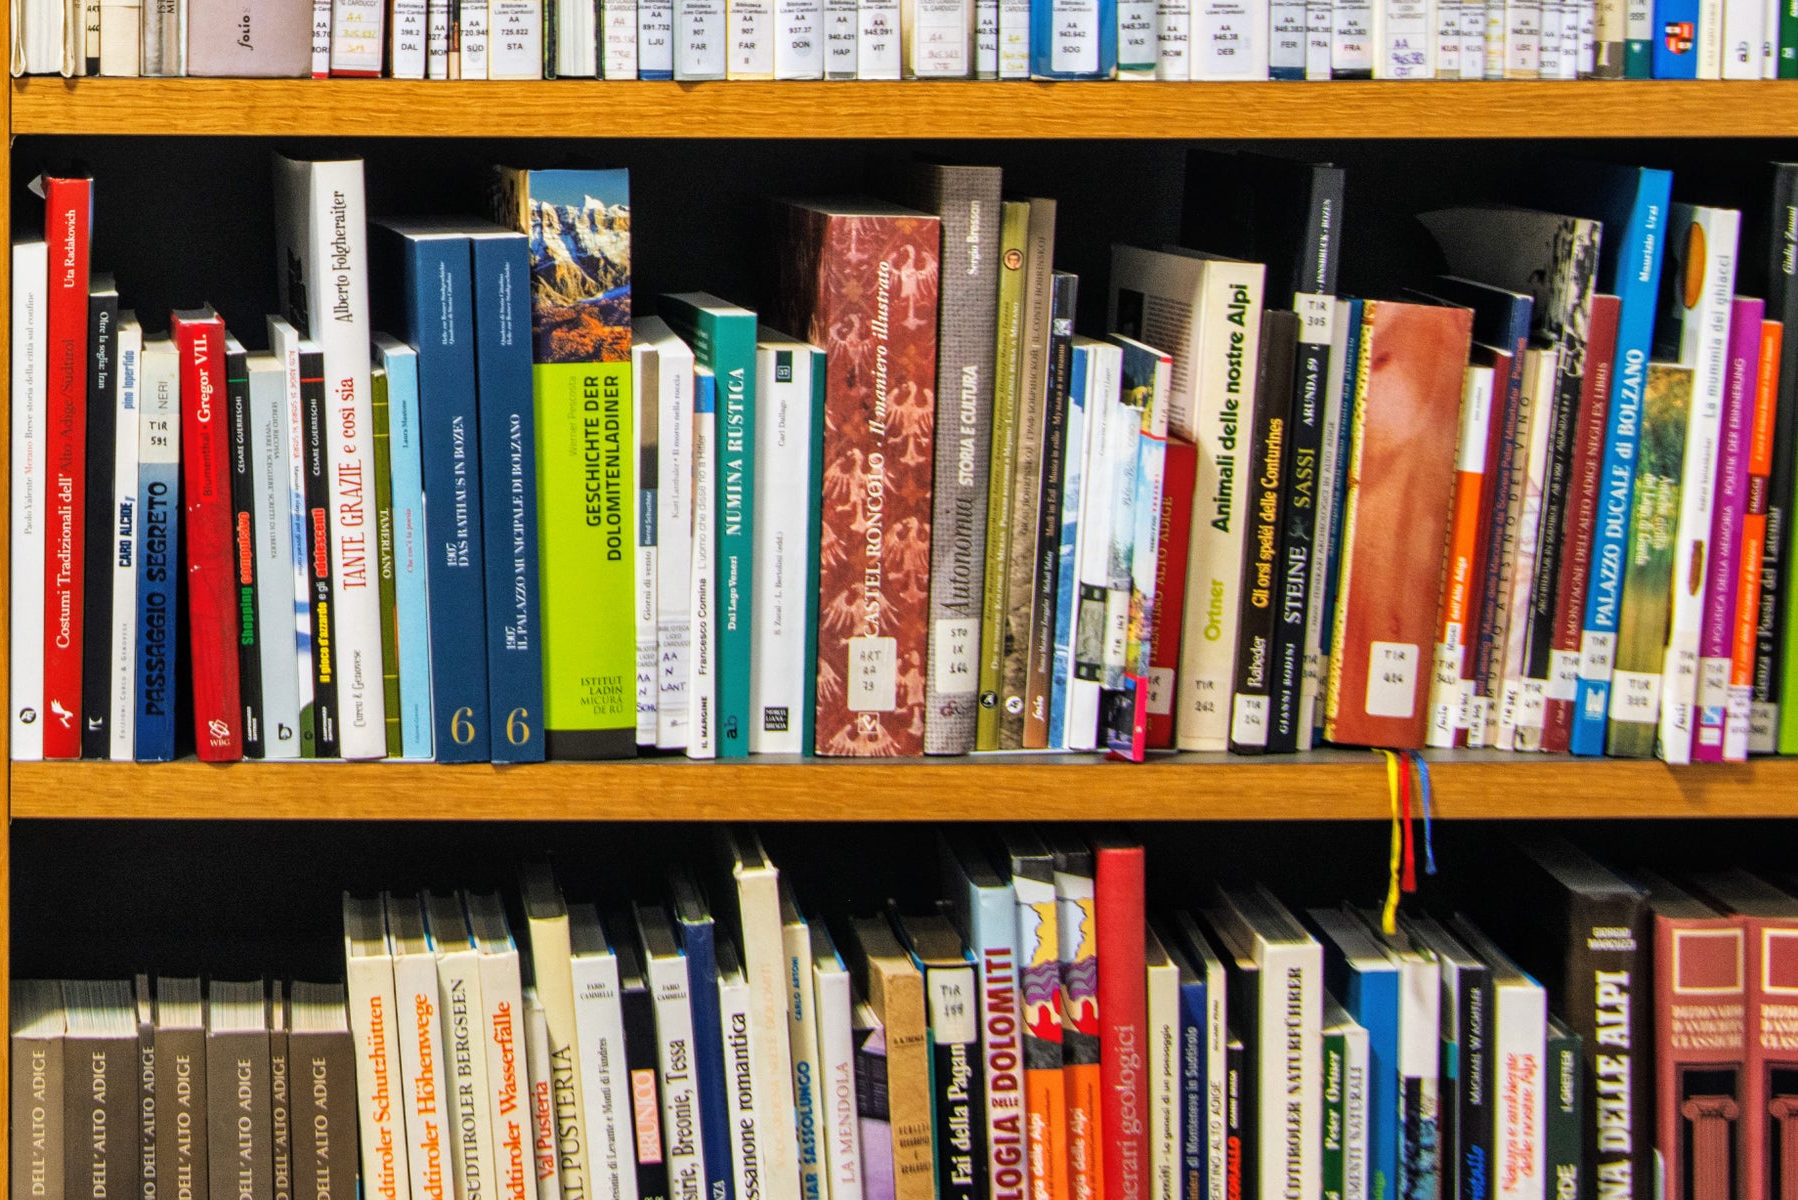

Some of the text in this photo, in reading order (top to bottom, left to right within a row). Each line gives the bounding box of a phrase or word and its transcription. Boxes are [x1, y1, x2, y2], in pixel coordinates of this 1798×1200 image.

[237, 15, 253, 50] folio
[193, 334, 213, 422] Gregor VII.
[1210, 284, 1250, 532] Animali delle nostre Alpi
[335, 377, 366, 590] TANTE GRAZIE e così sia
[583, 376, 601, 526] GESCHICHTE DER
[604, 375, 621, 560] DOLOMITENLADINER
[724, 368, 744, 534] NUMINA RUSTICA
[1293, 447, 1314, 507] SASSI
[1595, 349, 1644, 627] PALAZZO DUCALE di BOLZANO
[57, 505, 71, 586] Tradizionali
[145, 480, 169, 714] PASSAGGIO SEGRETO
[1284, 547, 1306, 623] STEINE
[56, 590, 70, 648] Costumi
[367, 996, 390, 1122] Schutzhütten
[414, 994, 436, 1114] Höhenwege
[451, 979, 471, 1076] BERGSEEN
[492, 1002, 516, 1115] Wasserfälle
[984, 946, 1018, 1092] DOLOMITI
[1595, 970, 1629, 1154] DELLE ALPI
[666, 1039, 694, 1156] Breonie, Tessa
[1113, 1025, 1142, 1134] geologici
